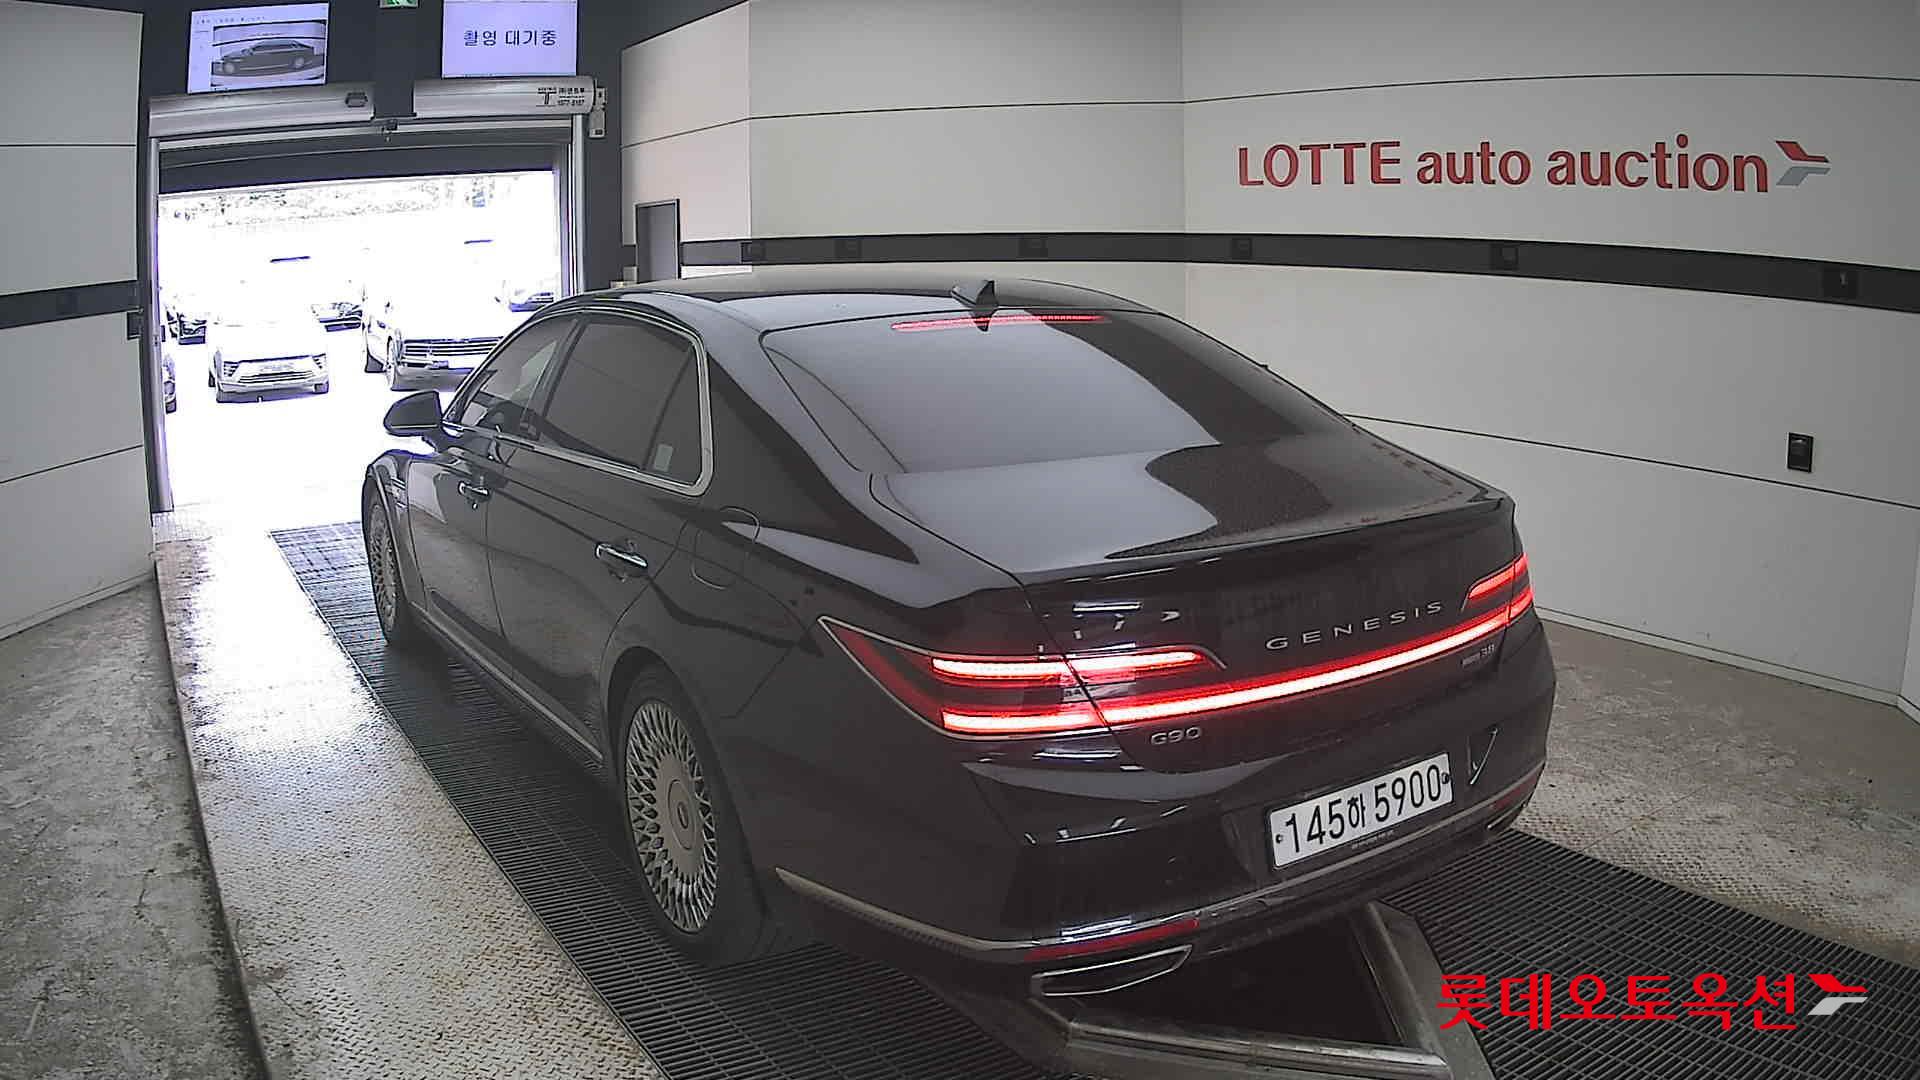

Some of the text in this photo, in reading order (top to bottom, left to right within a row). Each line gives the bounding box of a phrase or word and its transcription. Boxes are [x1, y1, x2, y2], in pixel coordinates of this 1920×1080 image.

[463, 30, 557, 47] 촬영 대기중
[1237, 133, 1769, 193] LOTTE auto auction
[1264, 600, 1443, 650] GENESIS
[1150, 726, 1201, 745] G90
[1285, 764, 1442, 853] 145하 5900
